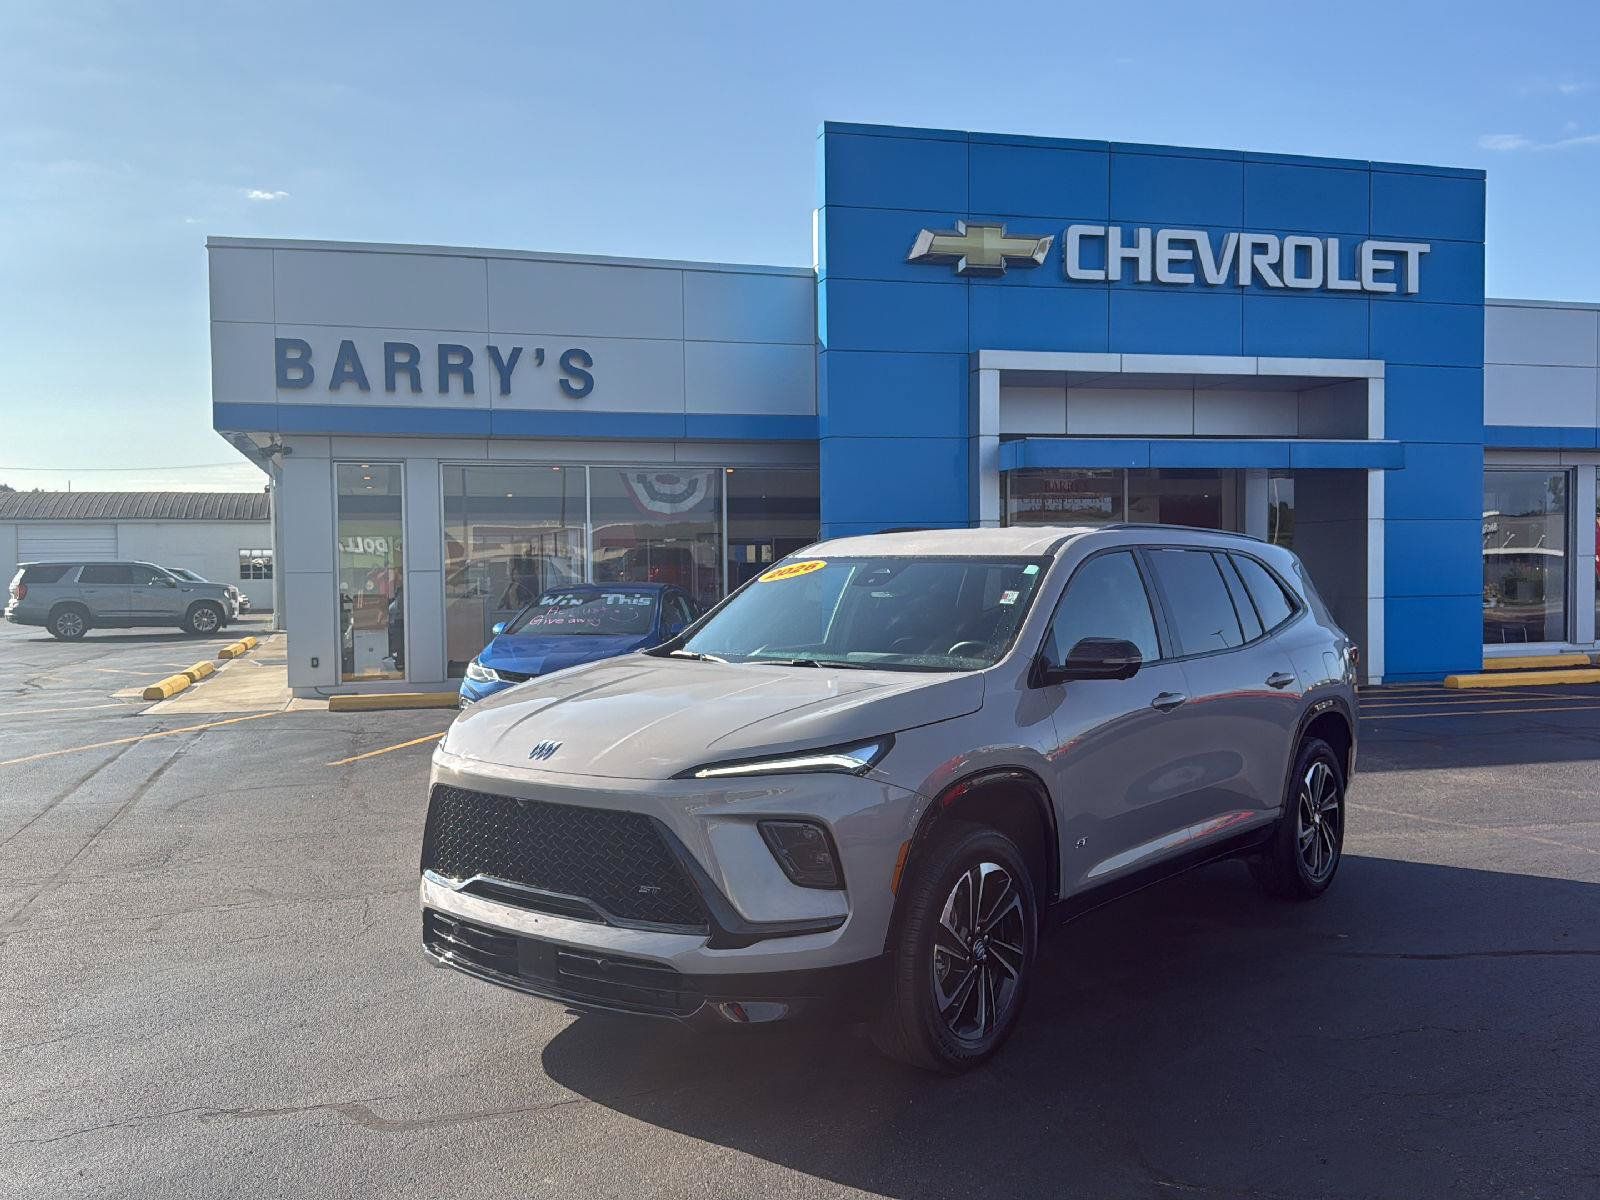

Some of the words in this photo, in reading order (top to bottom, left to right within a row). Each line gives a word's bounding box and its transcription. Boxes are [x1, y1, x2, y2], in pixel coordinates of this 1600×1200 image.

[1065, 224, 1431, 294] CHEVROLET
[274, 337, 595, 399] BARRY'S
[601, 593, 653, 606] This
